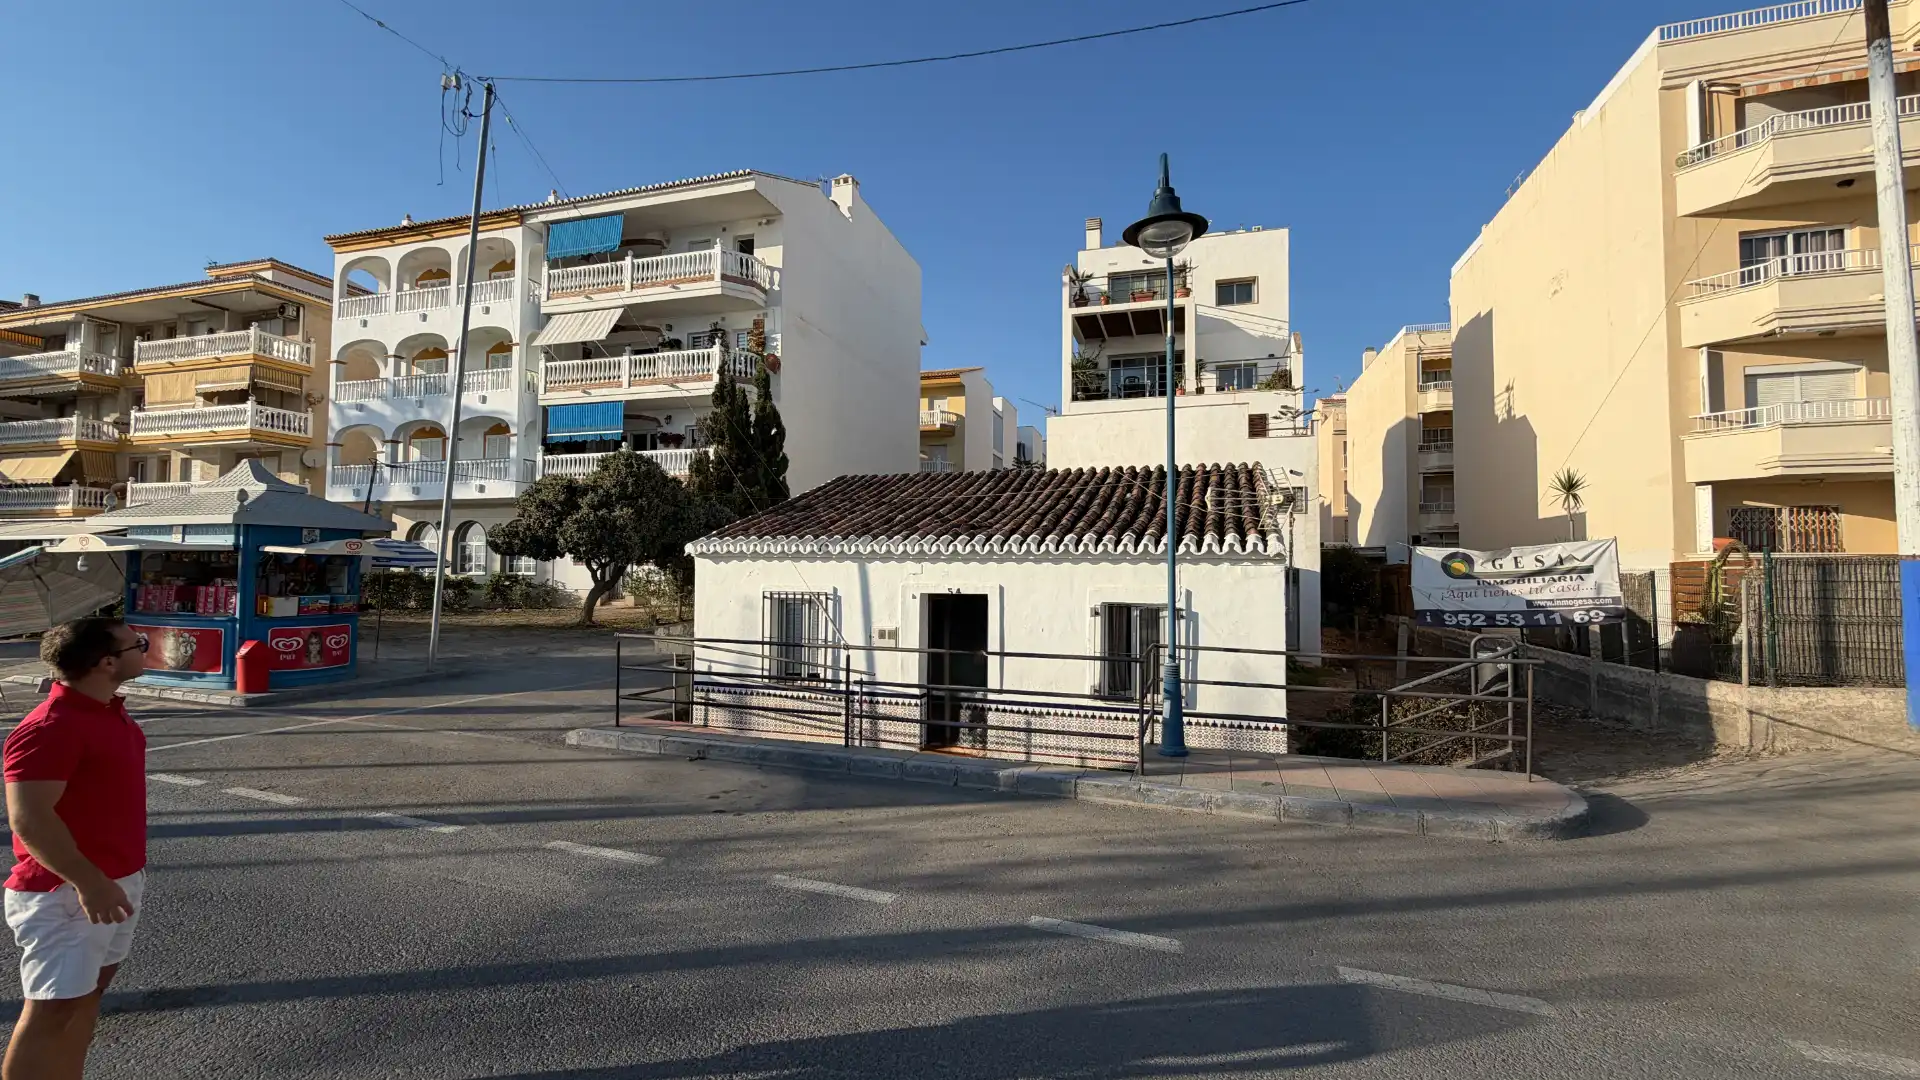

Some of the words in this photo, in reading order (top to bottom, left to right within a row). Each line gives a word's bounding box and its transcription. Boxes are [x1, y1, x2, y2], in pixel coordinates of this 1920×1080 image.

[1491, 553, 1565, 570] GESA
[1476, 575, 1585, 586] INMOBILIARIA
[1483, 587, 1524, 598] tienes
[1532, 597, 1613, 608] www.inmogesa.com
[1443, 612, 1488, 626] 952
[1495, 613, 1526, 626] 53
[1533, 612, 1563, 625] 11
[1573, 609, 1606, 624] 69
